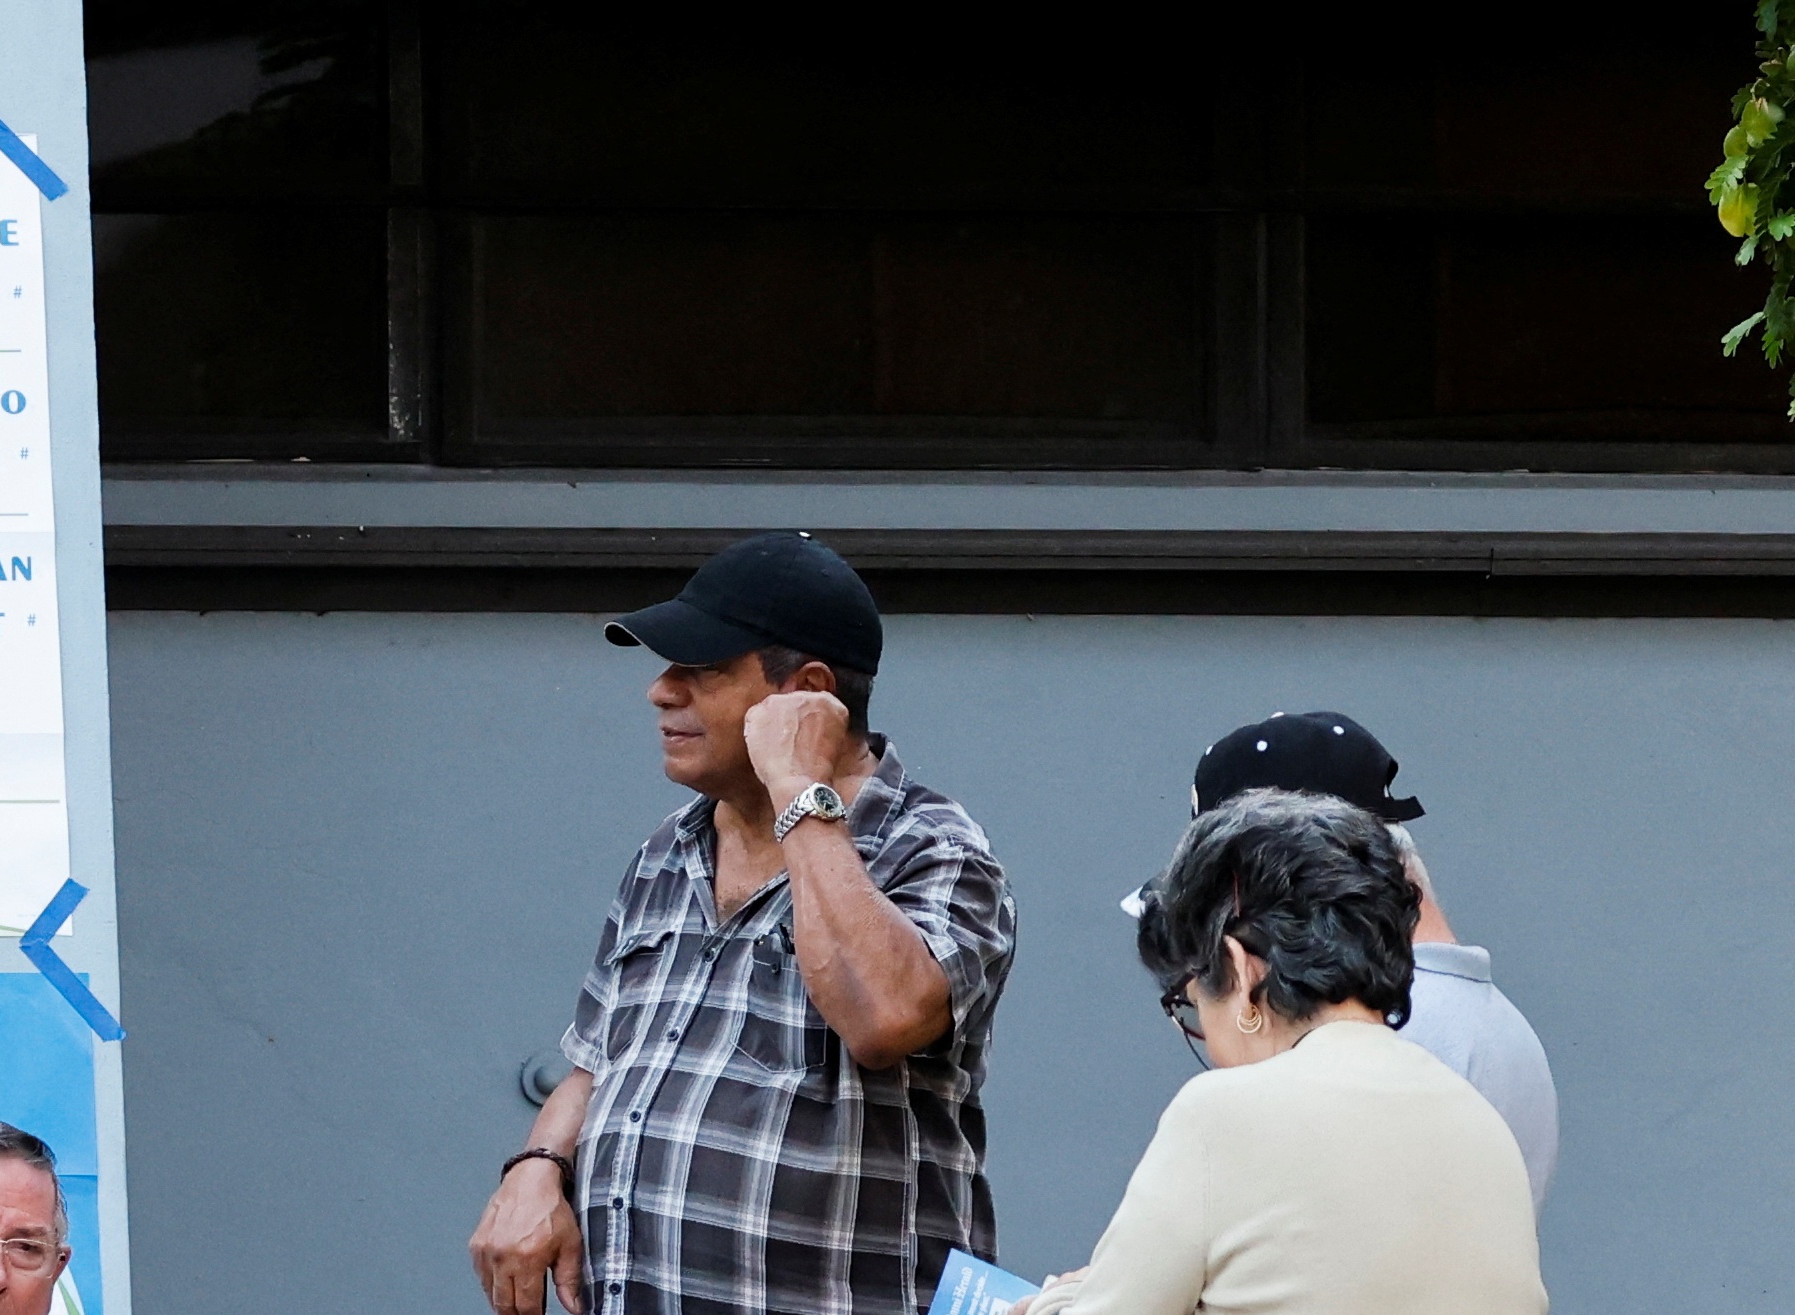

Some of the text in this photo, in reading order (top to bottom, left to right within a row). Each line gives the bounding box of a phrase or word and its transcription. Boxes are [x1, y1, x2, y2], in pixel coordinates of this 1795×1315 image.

[12, 285, 23, 300] #
[19, 446, 30, 460] #
[26, 613, 37, 627] #
[953, 1266, 973, 1298] Herald
